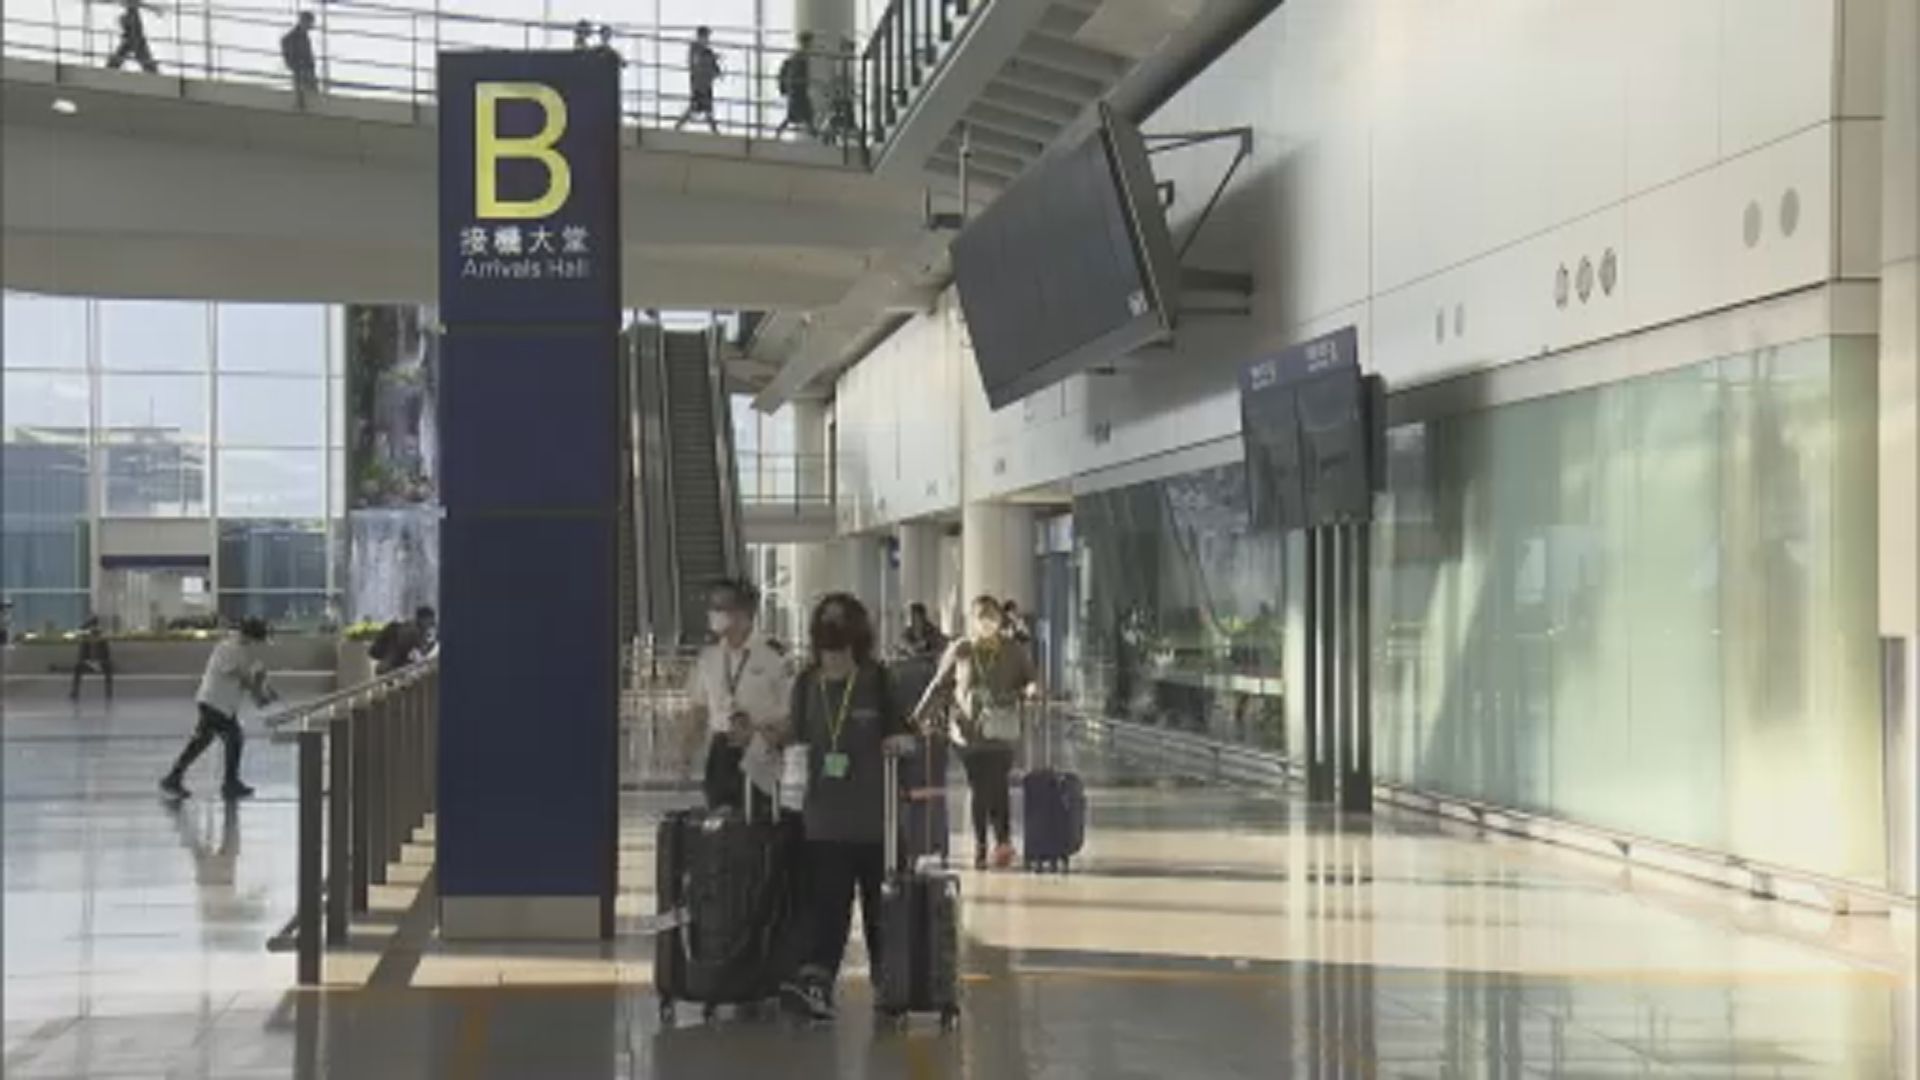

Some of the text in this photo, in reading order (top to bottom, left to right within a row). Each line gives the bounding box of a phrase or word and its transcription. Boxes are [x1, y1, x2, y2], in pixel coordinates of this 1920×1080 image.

[475, 81, 571, 219] B
[460, 225, 589, 255] 接機大堂
[461, 258, 589, 278] Arrivals Hall
